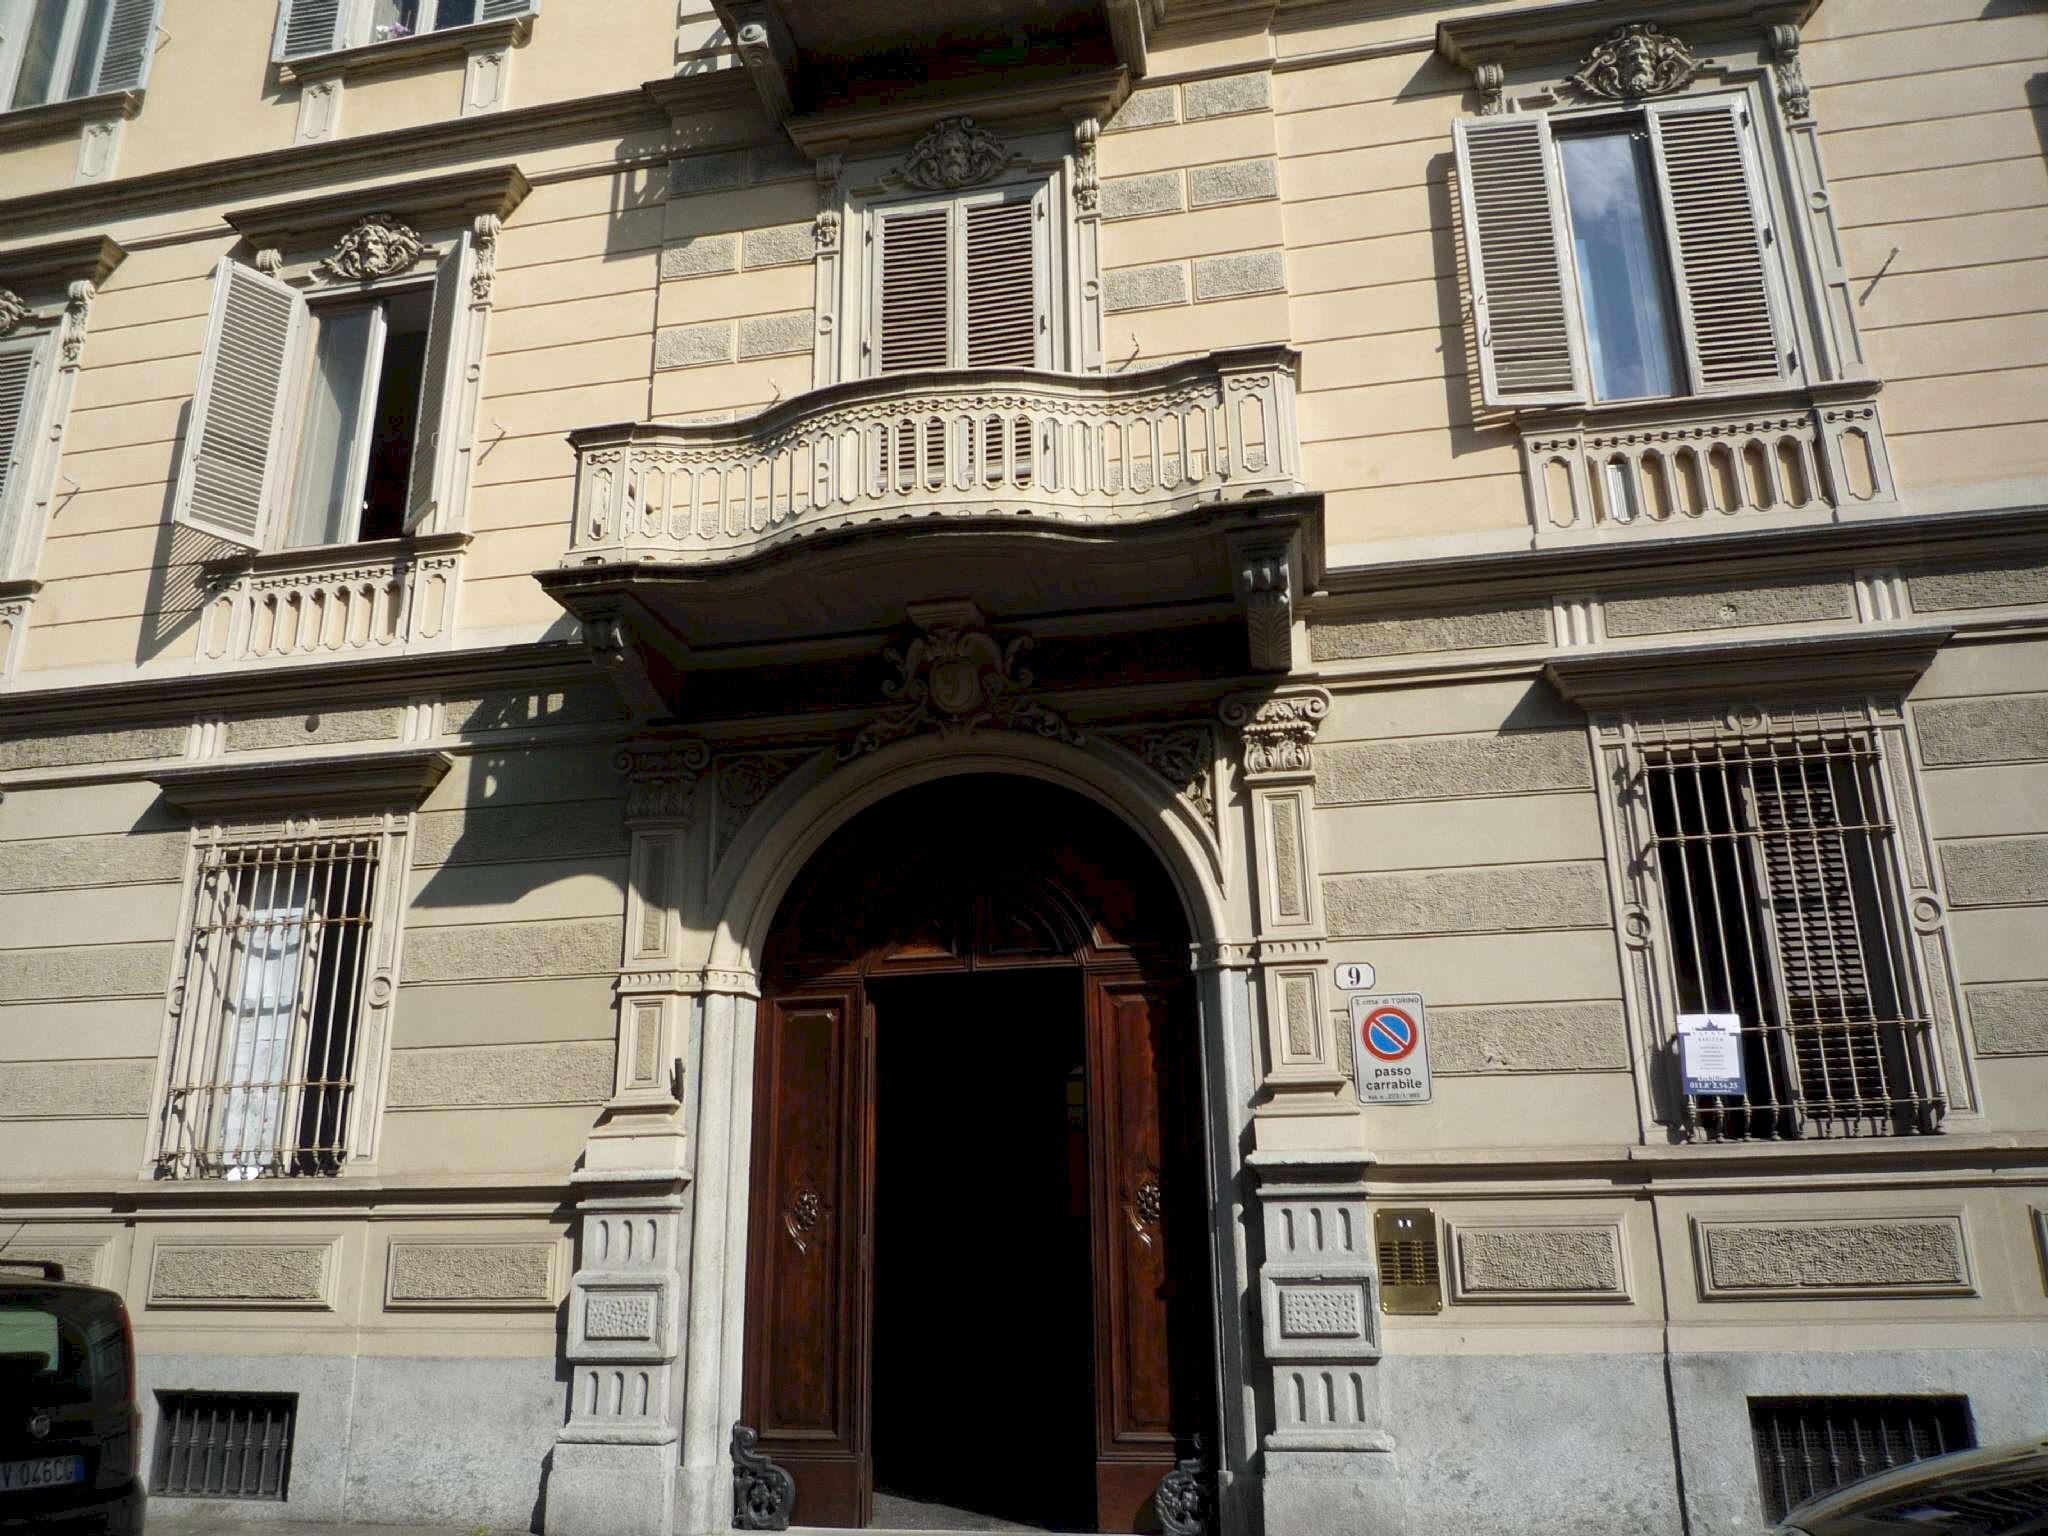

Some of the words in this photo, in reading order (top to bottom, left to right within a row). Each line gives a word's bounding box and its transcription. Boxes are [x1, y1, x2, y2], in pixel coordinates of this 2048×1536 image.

[1348, 966, 1361, 986] 9
[1374, 1066, 1411, 1078] passo
[1366, 1078, 1422, 1090] carrabile
